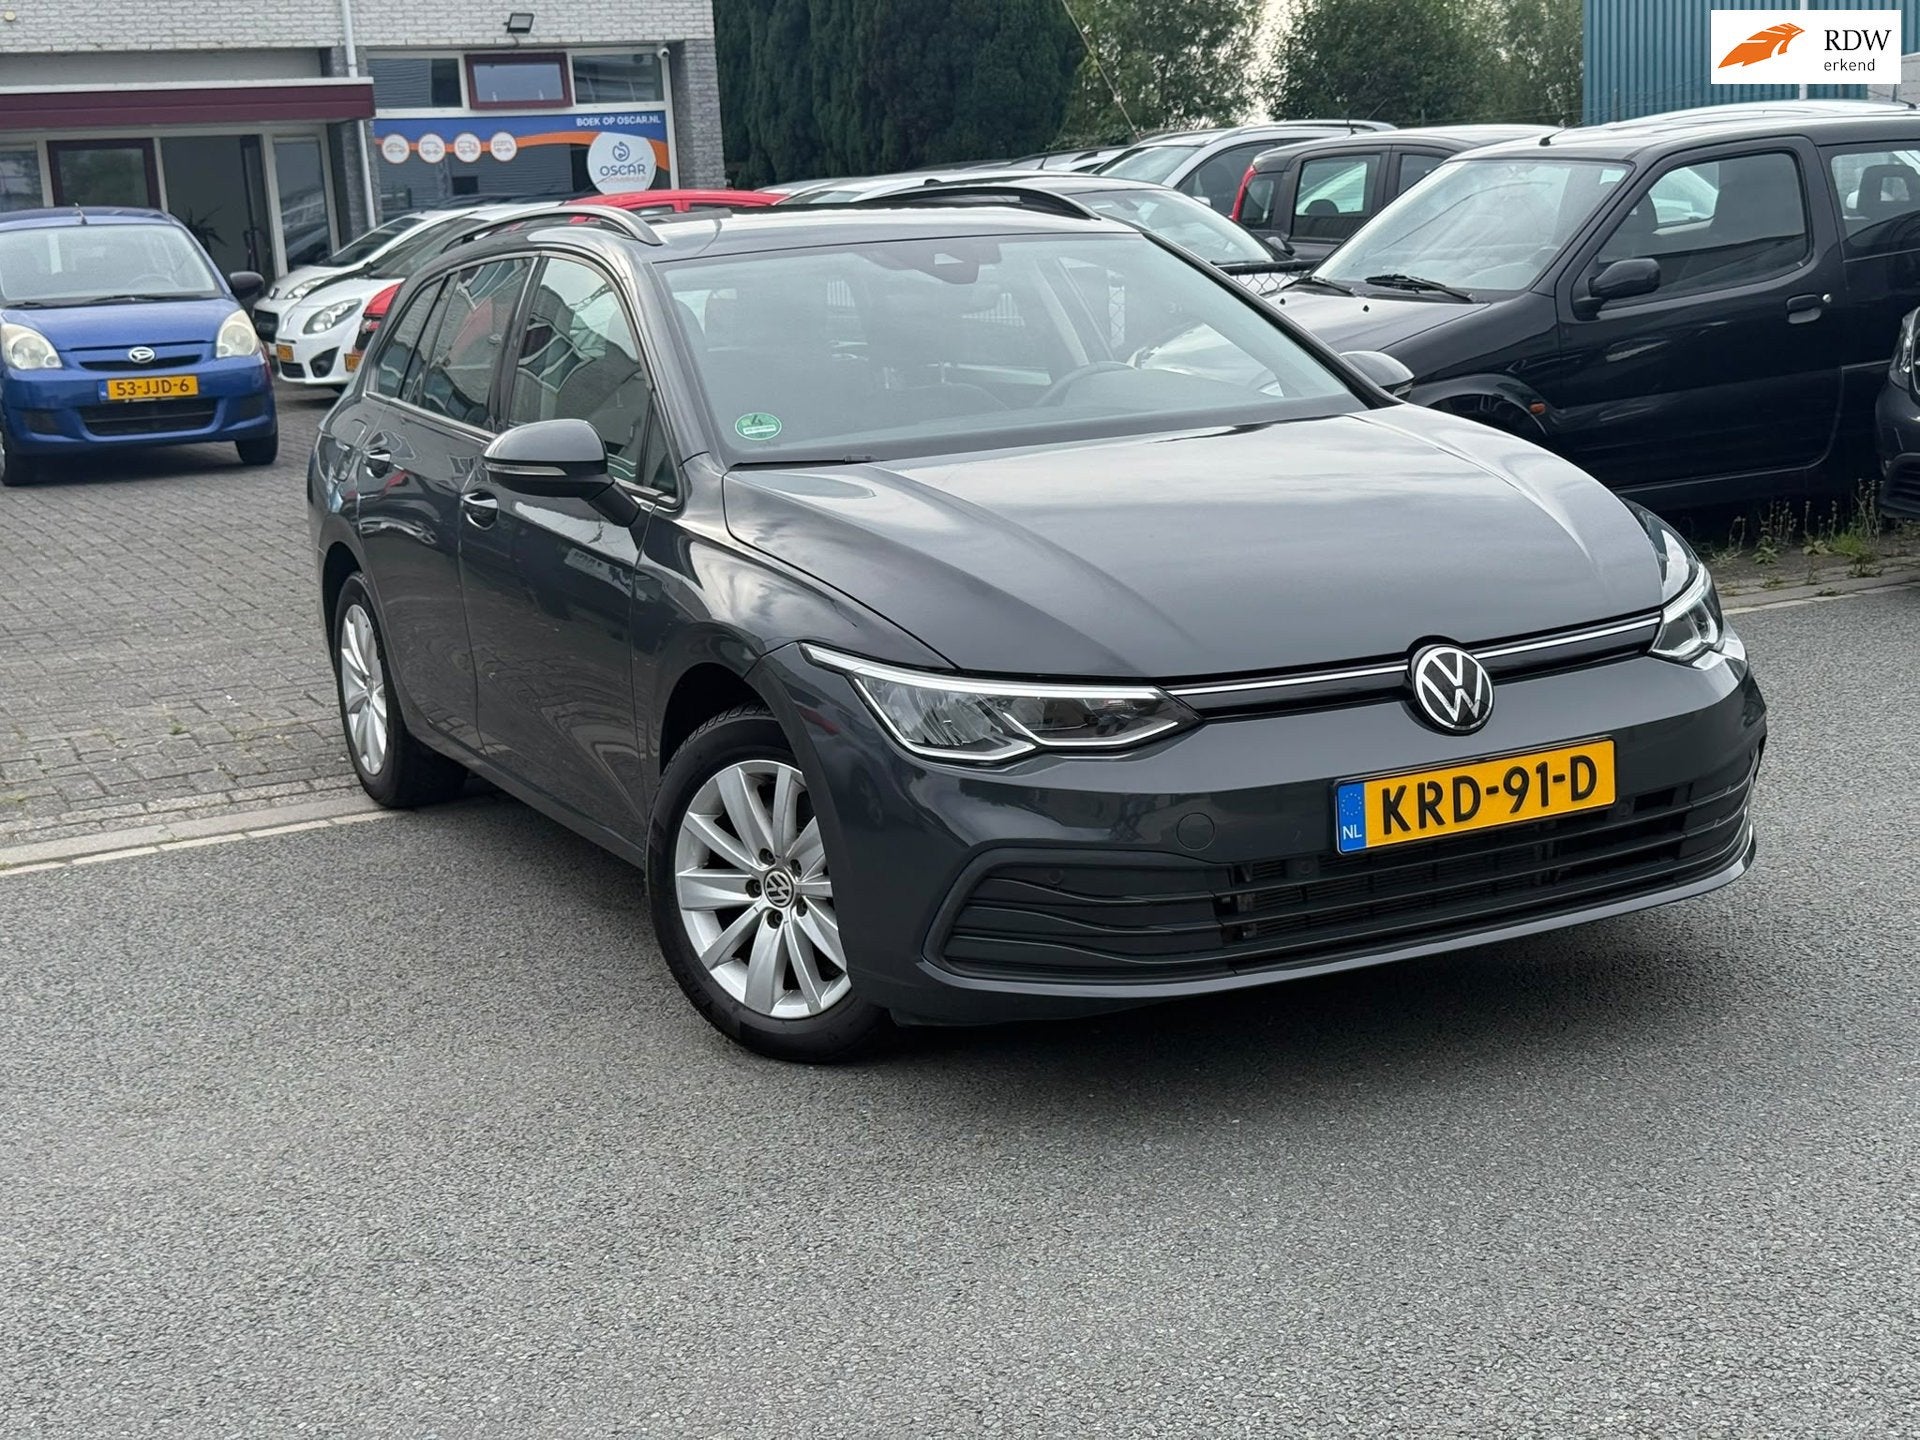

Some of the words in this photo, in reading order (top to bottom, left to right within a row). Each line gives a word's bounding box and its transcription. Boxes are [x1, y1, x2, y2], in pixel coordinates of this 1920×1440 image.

[576, 117, 601, 127] BOEK
[602, 116, 616, 126] OP
[616, 115, 661, 125] OSCAR.NL
[599, 163, 646, 177] OSCAR
[116, 379, 190, 396] 53-JJD-6
[1342, 825, 1362, 840] NL
[1382, 754, 1598, 836] KRD-91-D
